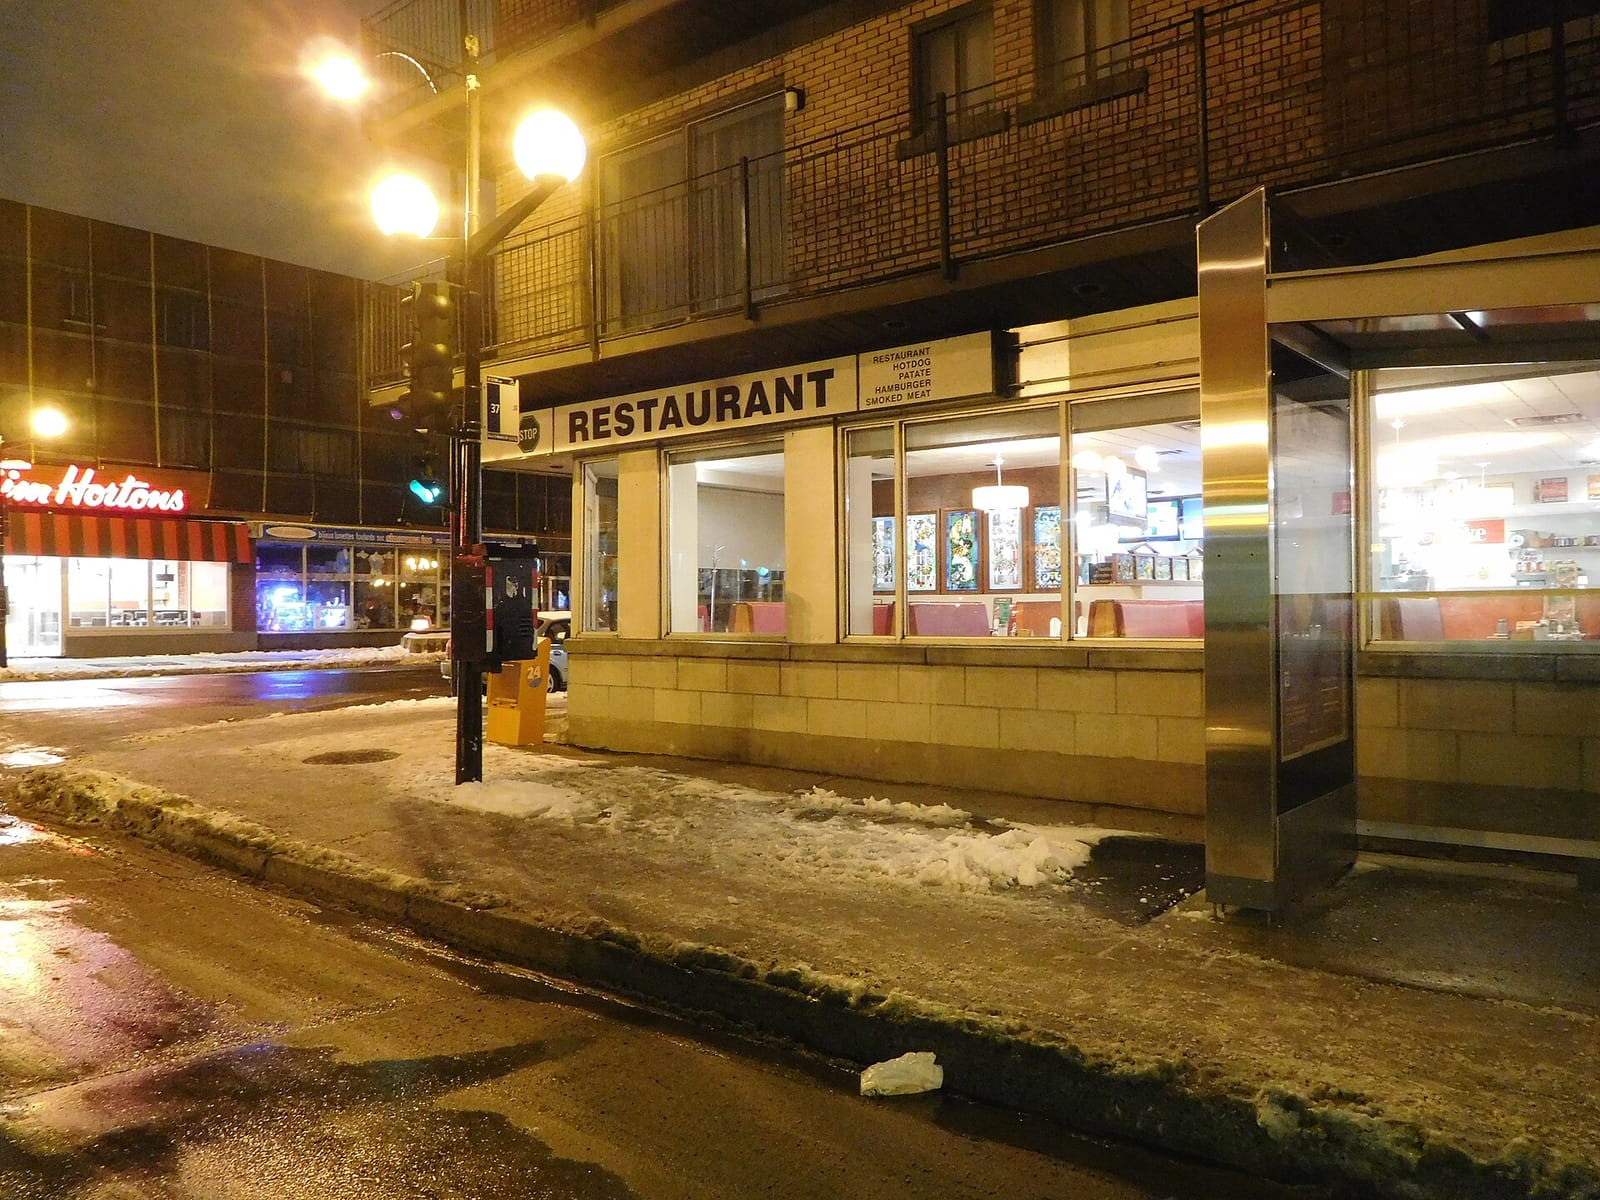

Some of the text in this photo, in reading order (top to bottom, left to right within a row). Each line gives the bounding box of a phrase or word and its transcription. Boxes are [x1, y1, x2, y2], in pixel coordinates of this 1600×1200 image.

[873, 347, 931, 364] RESTAURANT
[893, 358, 931, 371] HOTDOG
[899, 368, 931, 380] PATATE
[875, 379, 931, 394] HAMBURGER
[865, 389, 931, 406] SMOKED MEAT
[490, 403, 500, 414] 37
[568, 368, 835, 444] RESTAURANT
[519, 427, 538, 441] STOP
[55, 464, 184, 511] Hortons
[527, 665, 541, 679] 24
